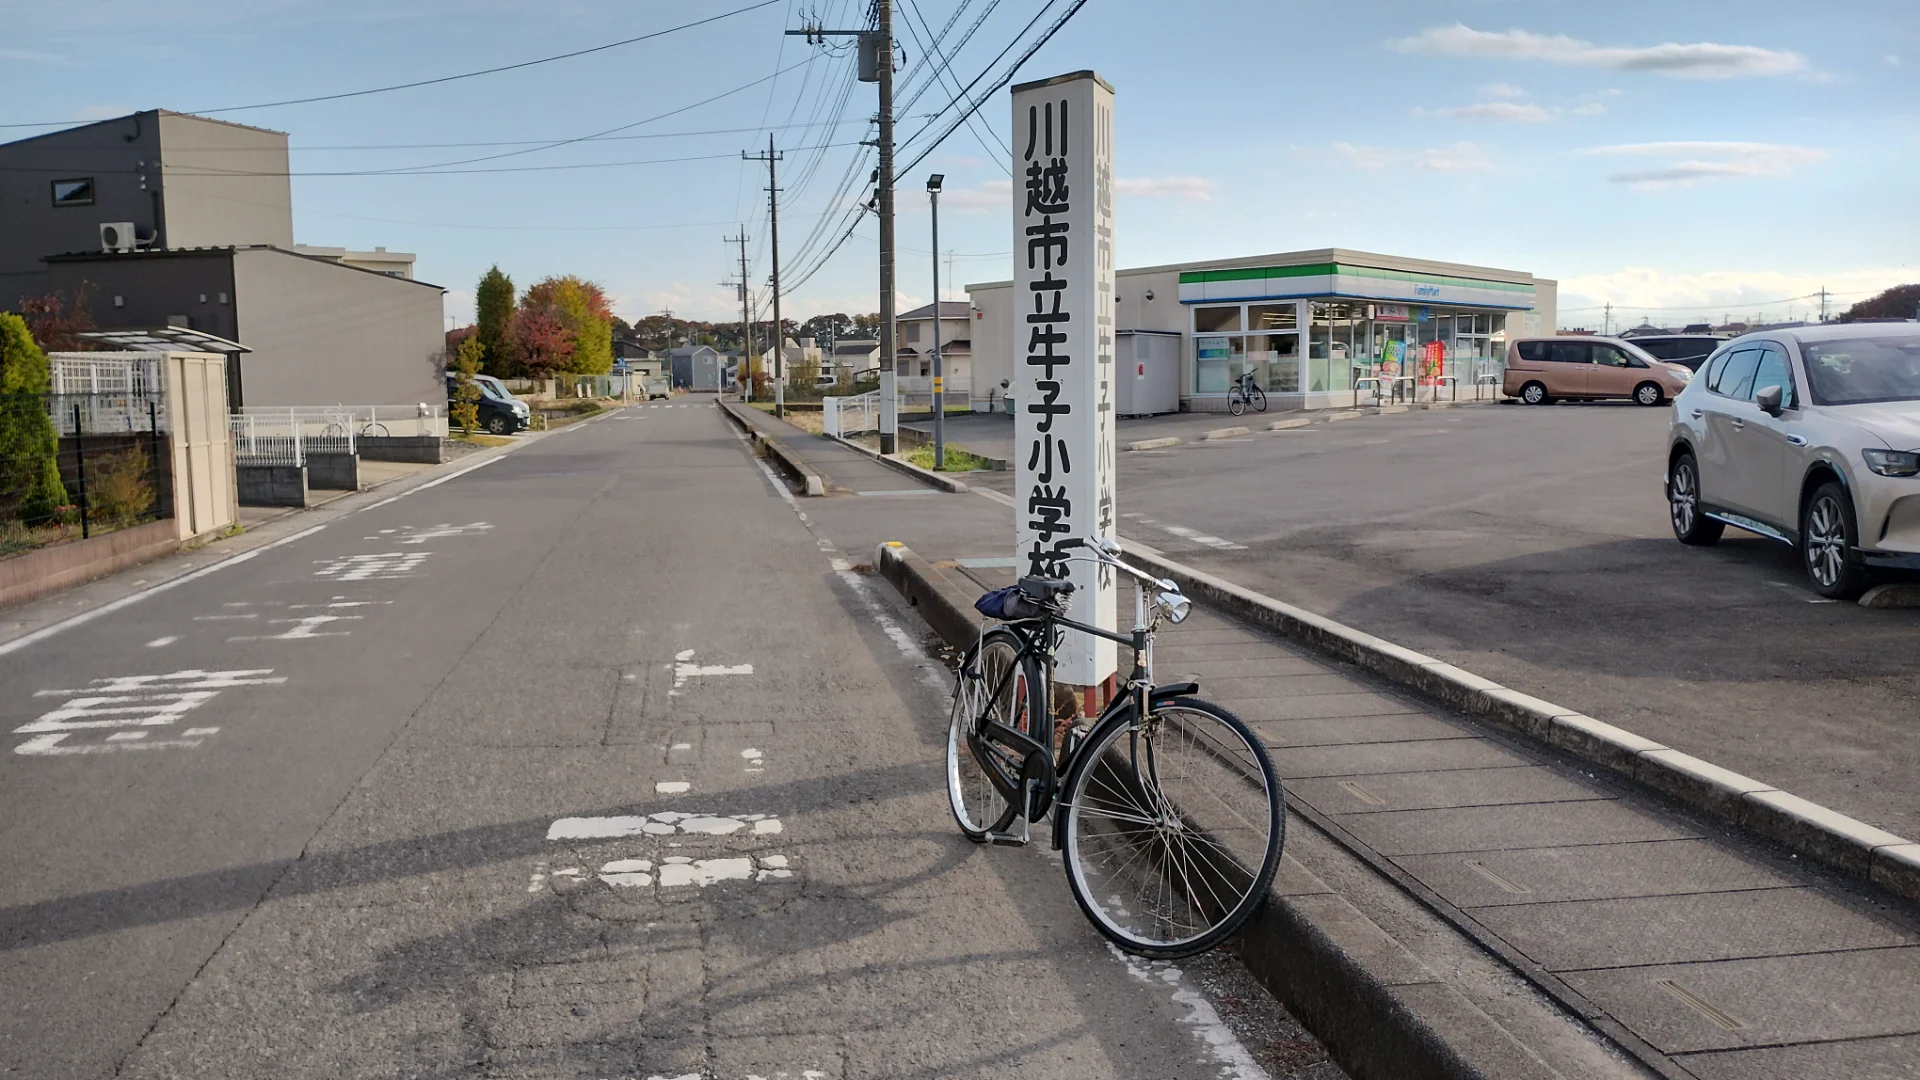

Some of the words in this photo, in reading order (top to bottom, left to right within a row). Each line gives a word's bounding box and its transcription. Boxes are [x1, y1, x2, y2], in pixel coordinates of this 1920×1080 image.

[1024, 99, 1071, 578] 川越市立牛子小学校
